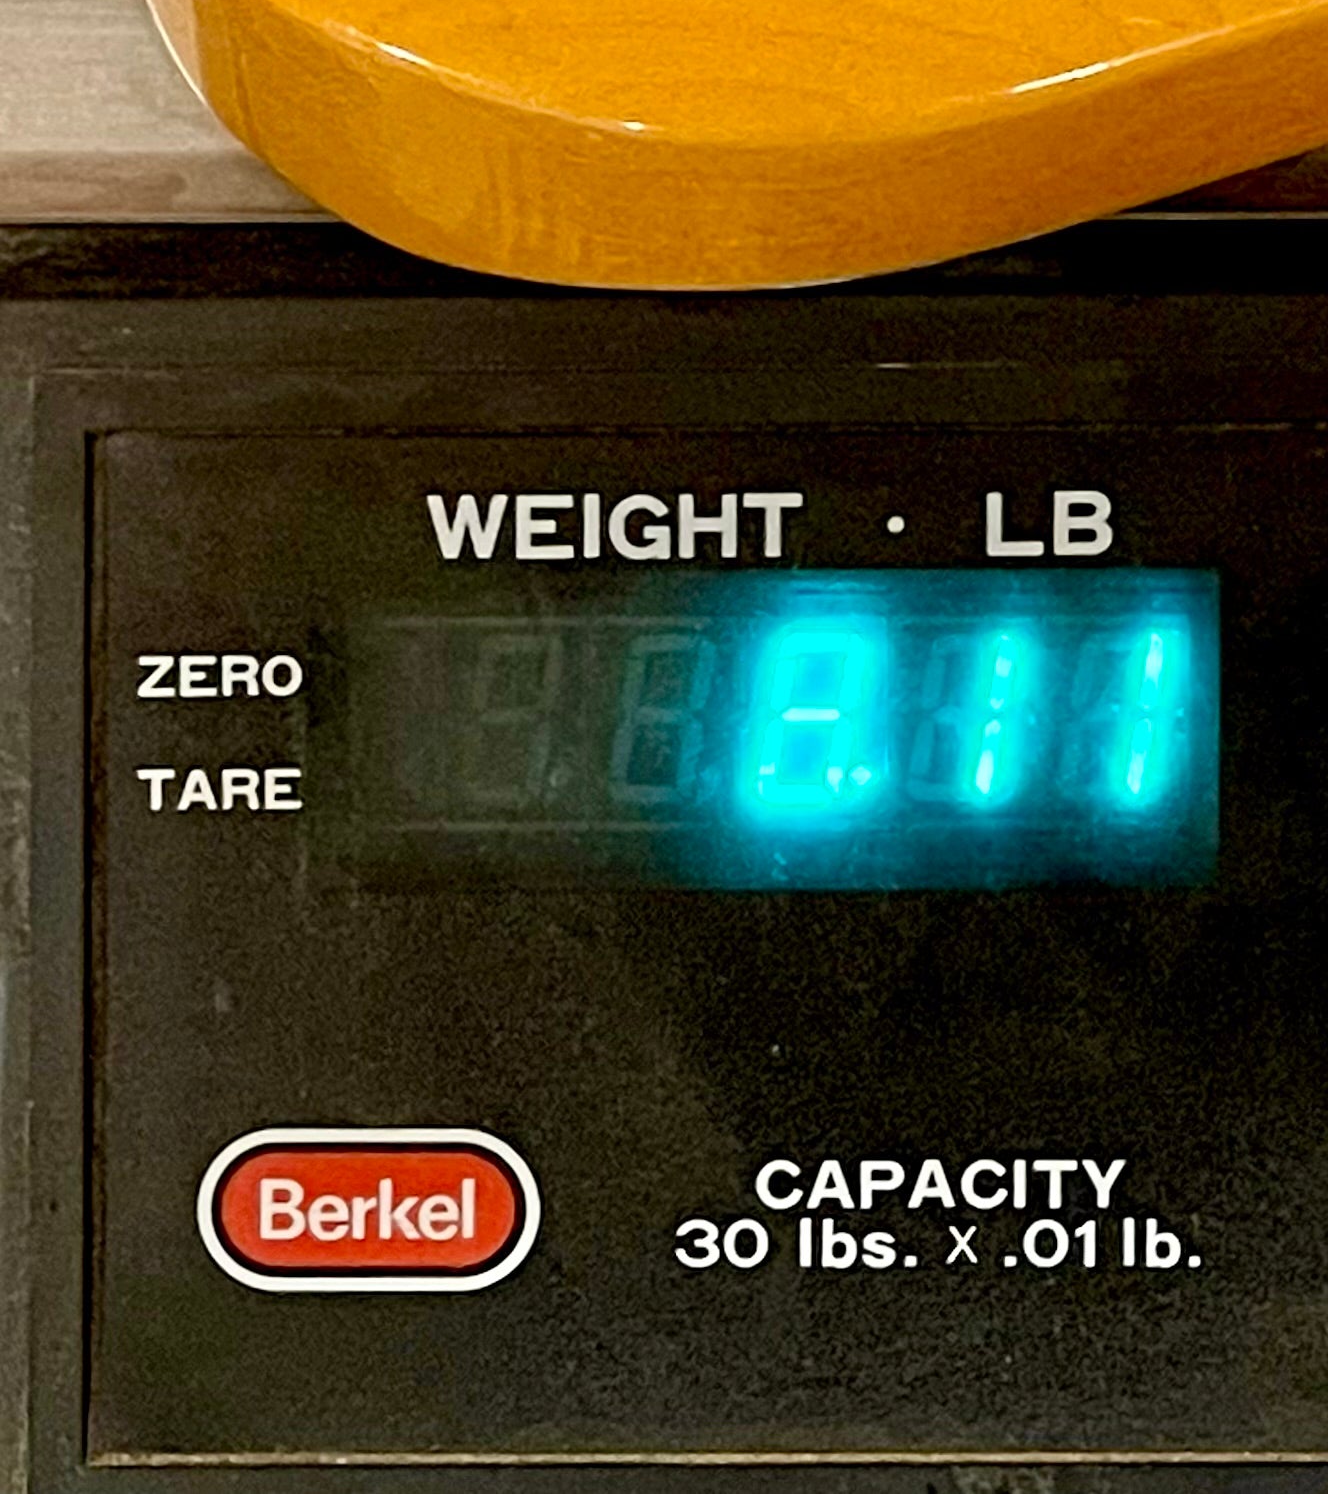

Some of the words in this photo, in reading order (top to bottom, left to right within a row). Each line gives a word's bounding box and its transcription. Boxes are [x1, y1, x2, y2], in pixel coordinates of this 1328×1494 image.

[427, 493, 802, 560] WEIGHT
[986, 491, 1113, 557] LB
[136, 655, 303, 698] ZERO
[136, 768, 303, 811] TARE
[259, 1178, 475, 1241] Berkel
[755, 1158, 1126, 1210] CAPACITY
[674, 1218, 769, 1269] 30
[799, 1217, 918, 1269] lbs.
[1003, 1218, 1096, 1268] .01
[1122, 1216, 1202, 1269] lb.
